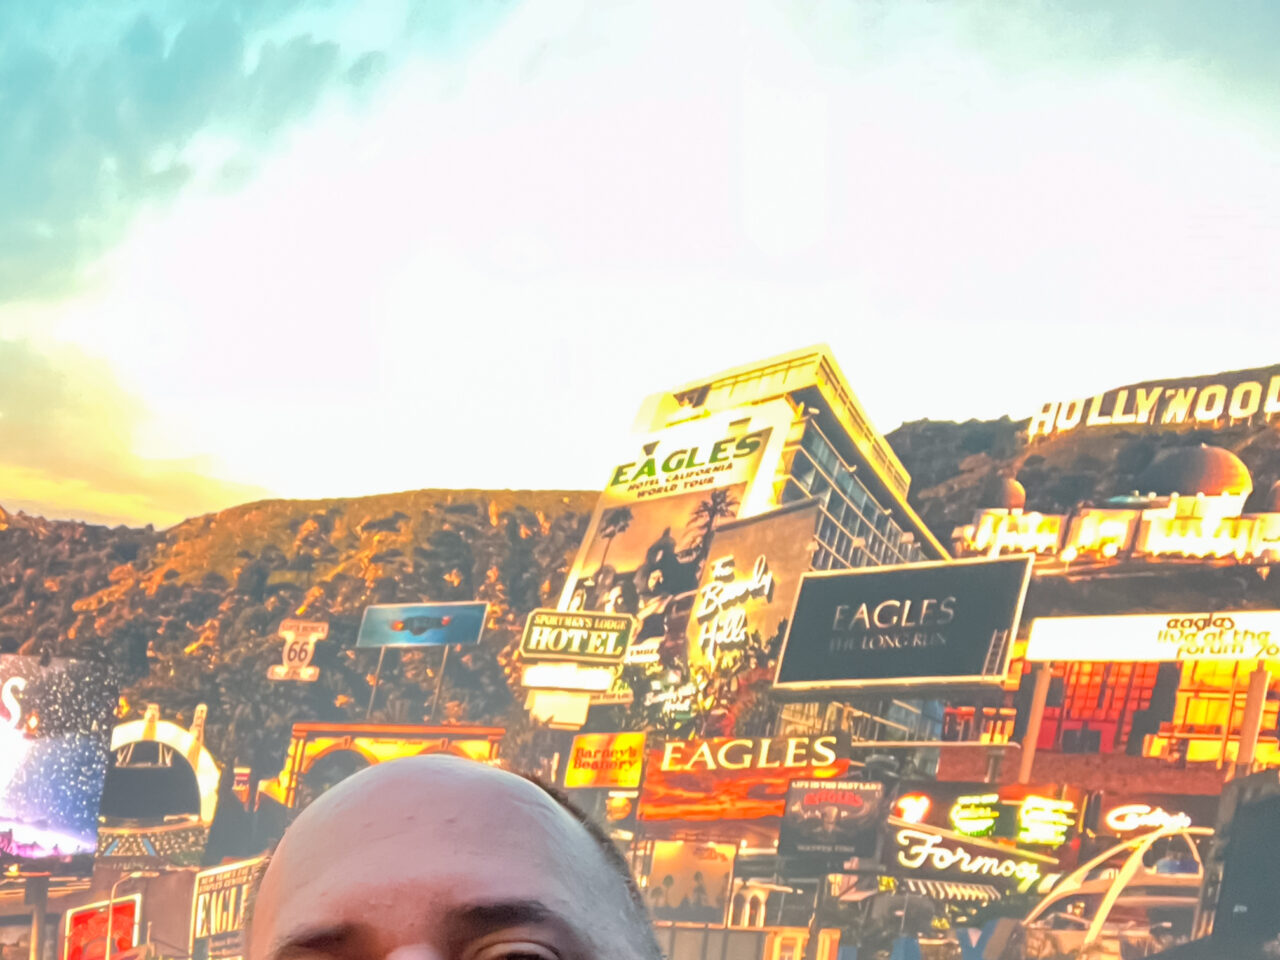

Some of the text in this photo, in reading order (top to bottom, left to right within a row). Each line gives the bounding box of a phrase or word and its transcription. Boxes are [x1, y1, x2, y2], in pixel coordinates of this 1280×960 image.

[610, 432, 763, 487] EAGLES
[627, 462, 733, 491] HOTEL CALIFORNIA
[637, 476, 715, 498] WORLD TOUR
[832, 596, 956, 631] EAGLES
[287, 641, 308, 662] 66
[527, 626, 623, 656] HOTEL
[660, 736, 837, 772] EAGLES
